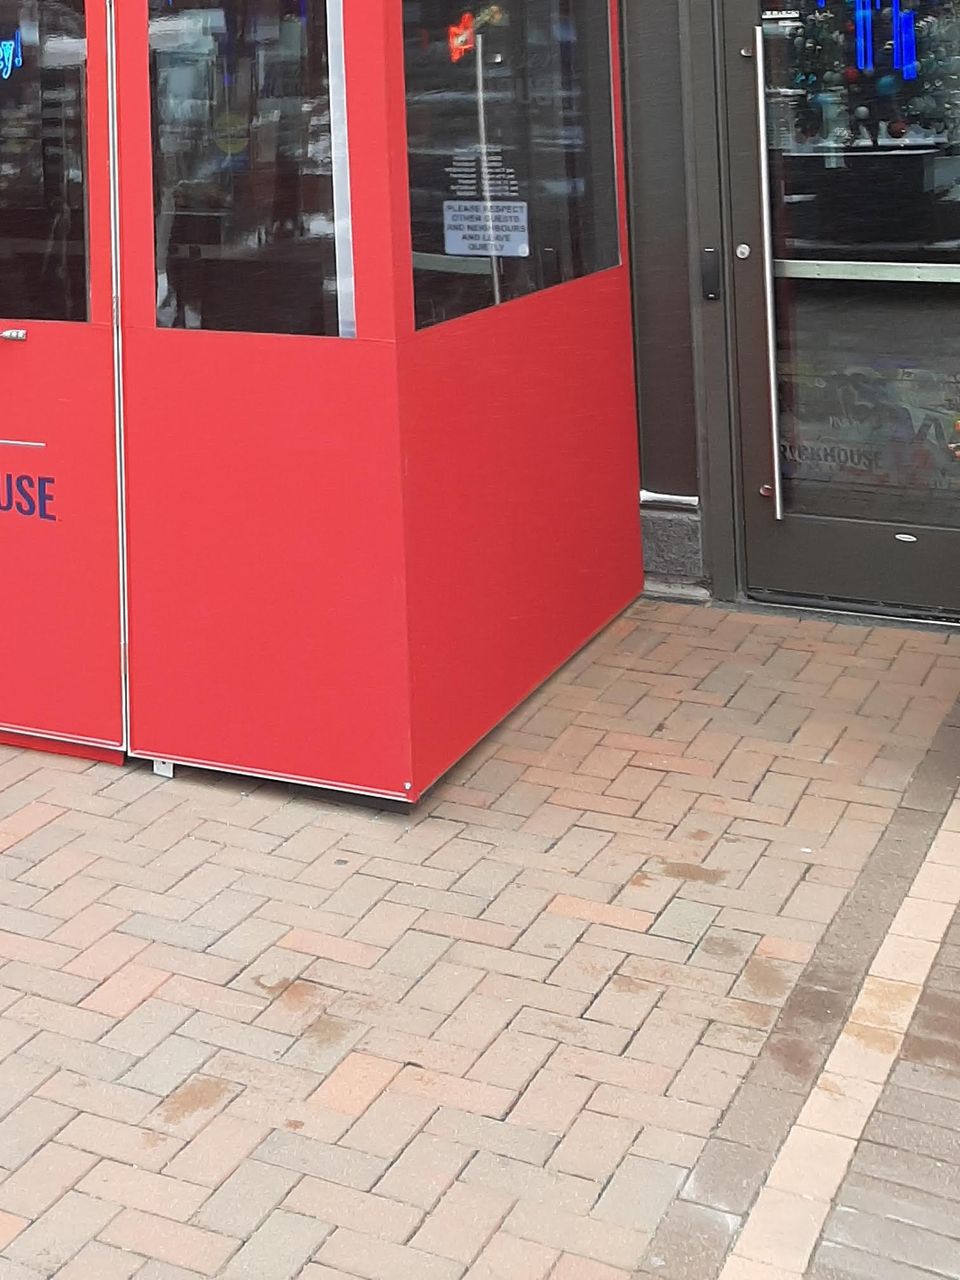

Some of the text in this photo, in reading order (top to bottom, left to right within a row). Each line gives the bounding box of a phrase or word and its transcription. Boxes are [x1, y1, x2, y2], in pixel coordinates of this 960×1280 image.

[446, 205, 480, 213] PLEASE
[446, 223, 464, 231] AND
[461, 233, 480, 241] AND
